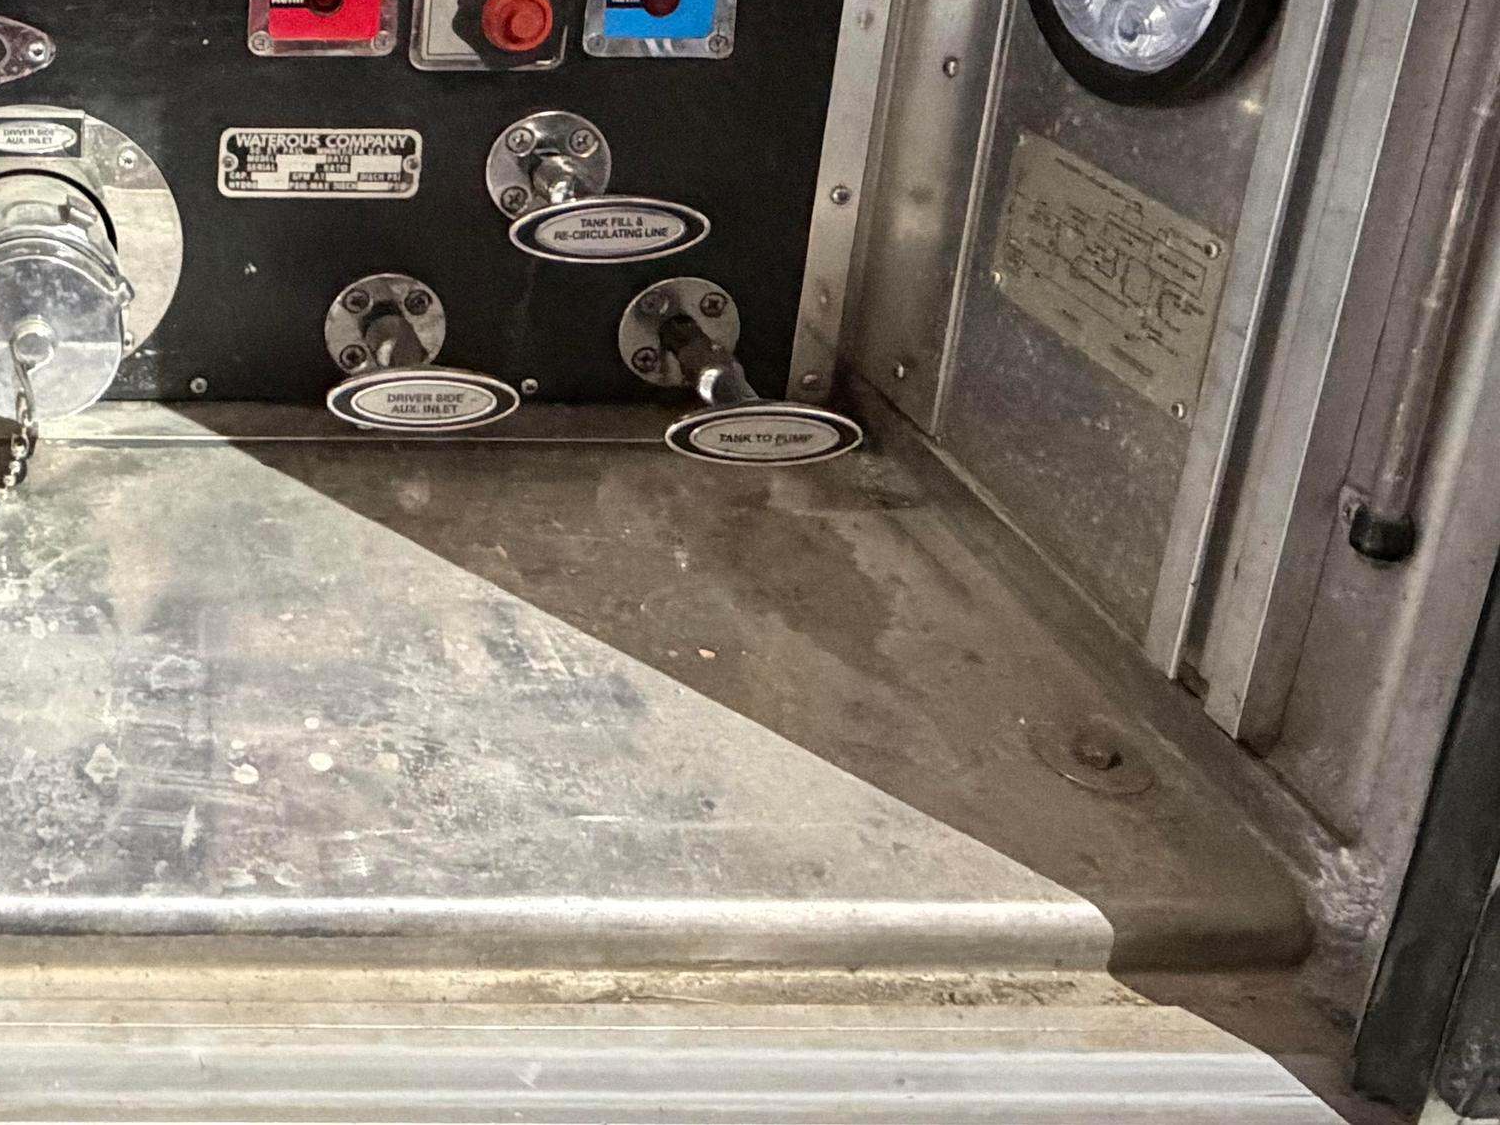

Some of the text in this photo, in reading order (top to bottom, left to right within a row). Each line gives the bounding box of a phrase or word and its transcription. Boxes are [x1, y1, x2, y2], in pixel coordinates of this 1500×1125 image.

[235, 134, 409, 148] WATEROUS COMPANY
[581, 218, 608, 227] TANK
[611, 218, 631, 226] FILL
[554, 227, 668, 240] RE-CIRCULATING LINE
[387, 393, 465, 403] DRIVER SIDE
[391, 405, 457, 414] AUX. INLET
[719, 434, 813, 445] TANK TO PUMP
